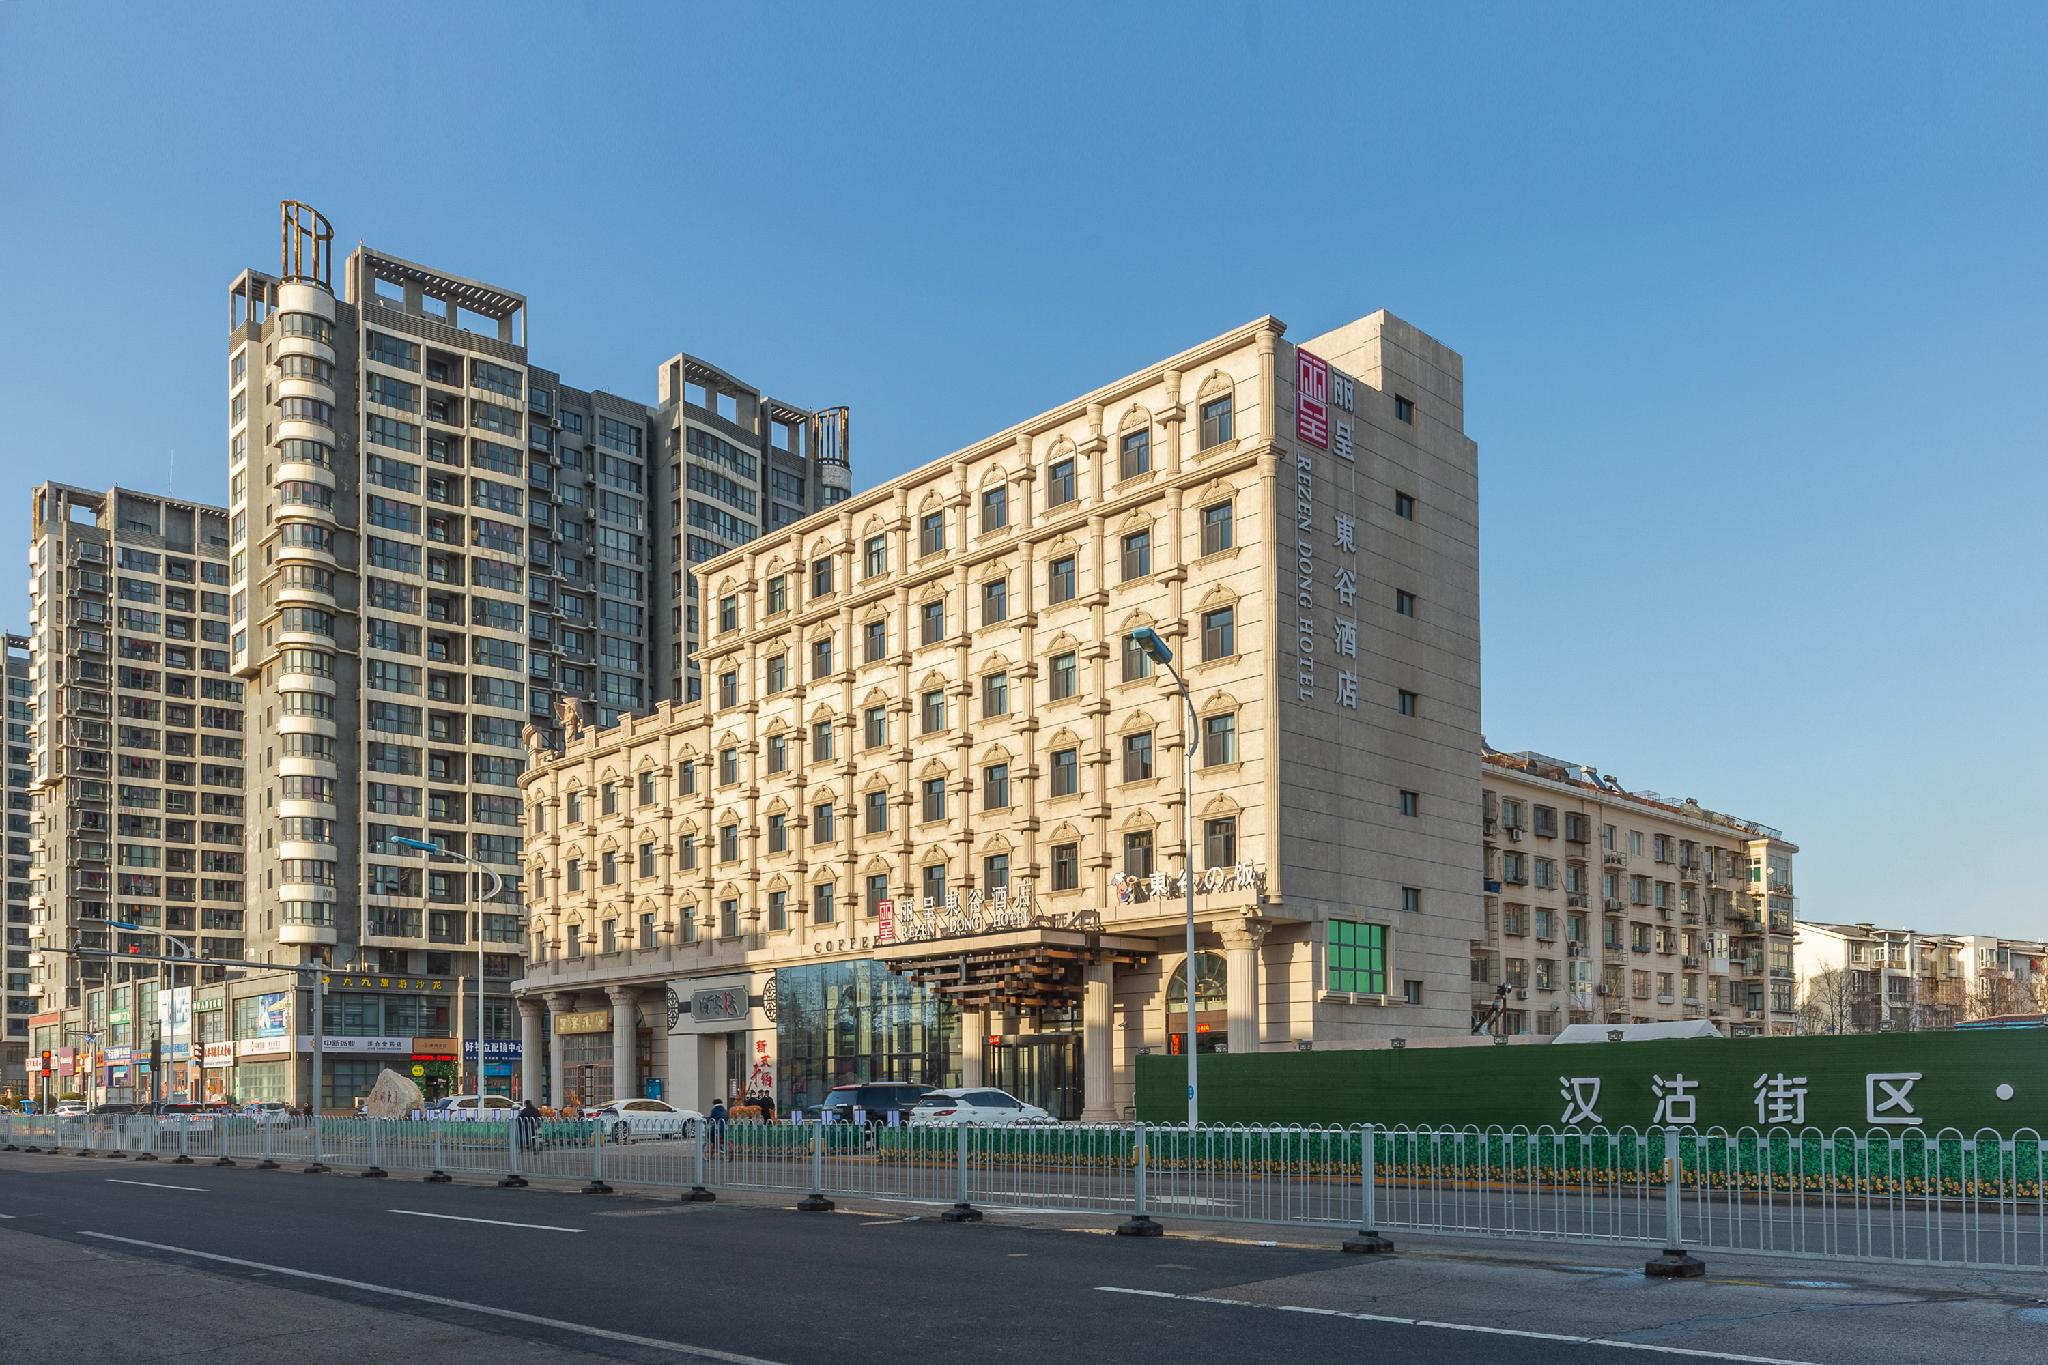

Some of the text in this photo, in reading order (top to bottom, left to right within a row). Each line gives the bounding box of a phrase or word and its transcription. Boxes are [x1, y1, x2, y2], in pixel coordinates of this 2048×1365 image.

[1296, 452, 1314, 701] REZEN DONG HOTEL
[900, 908, 1030, 940] REZEN DONG HOTEL
[814, 935, 881, 955] COFFEE
